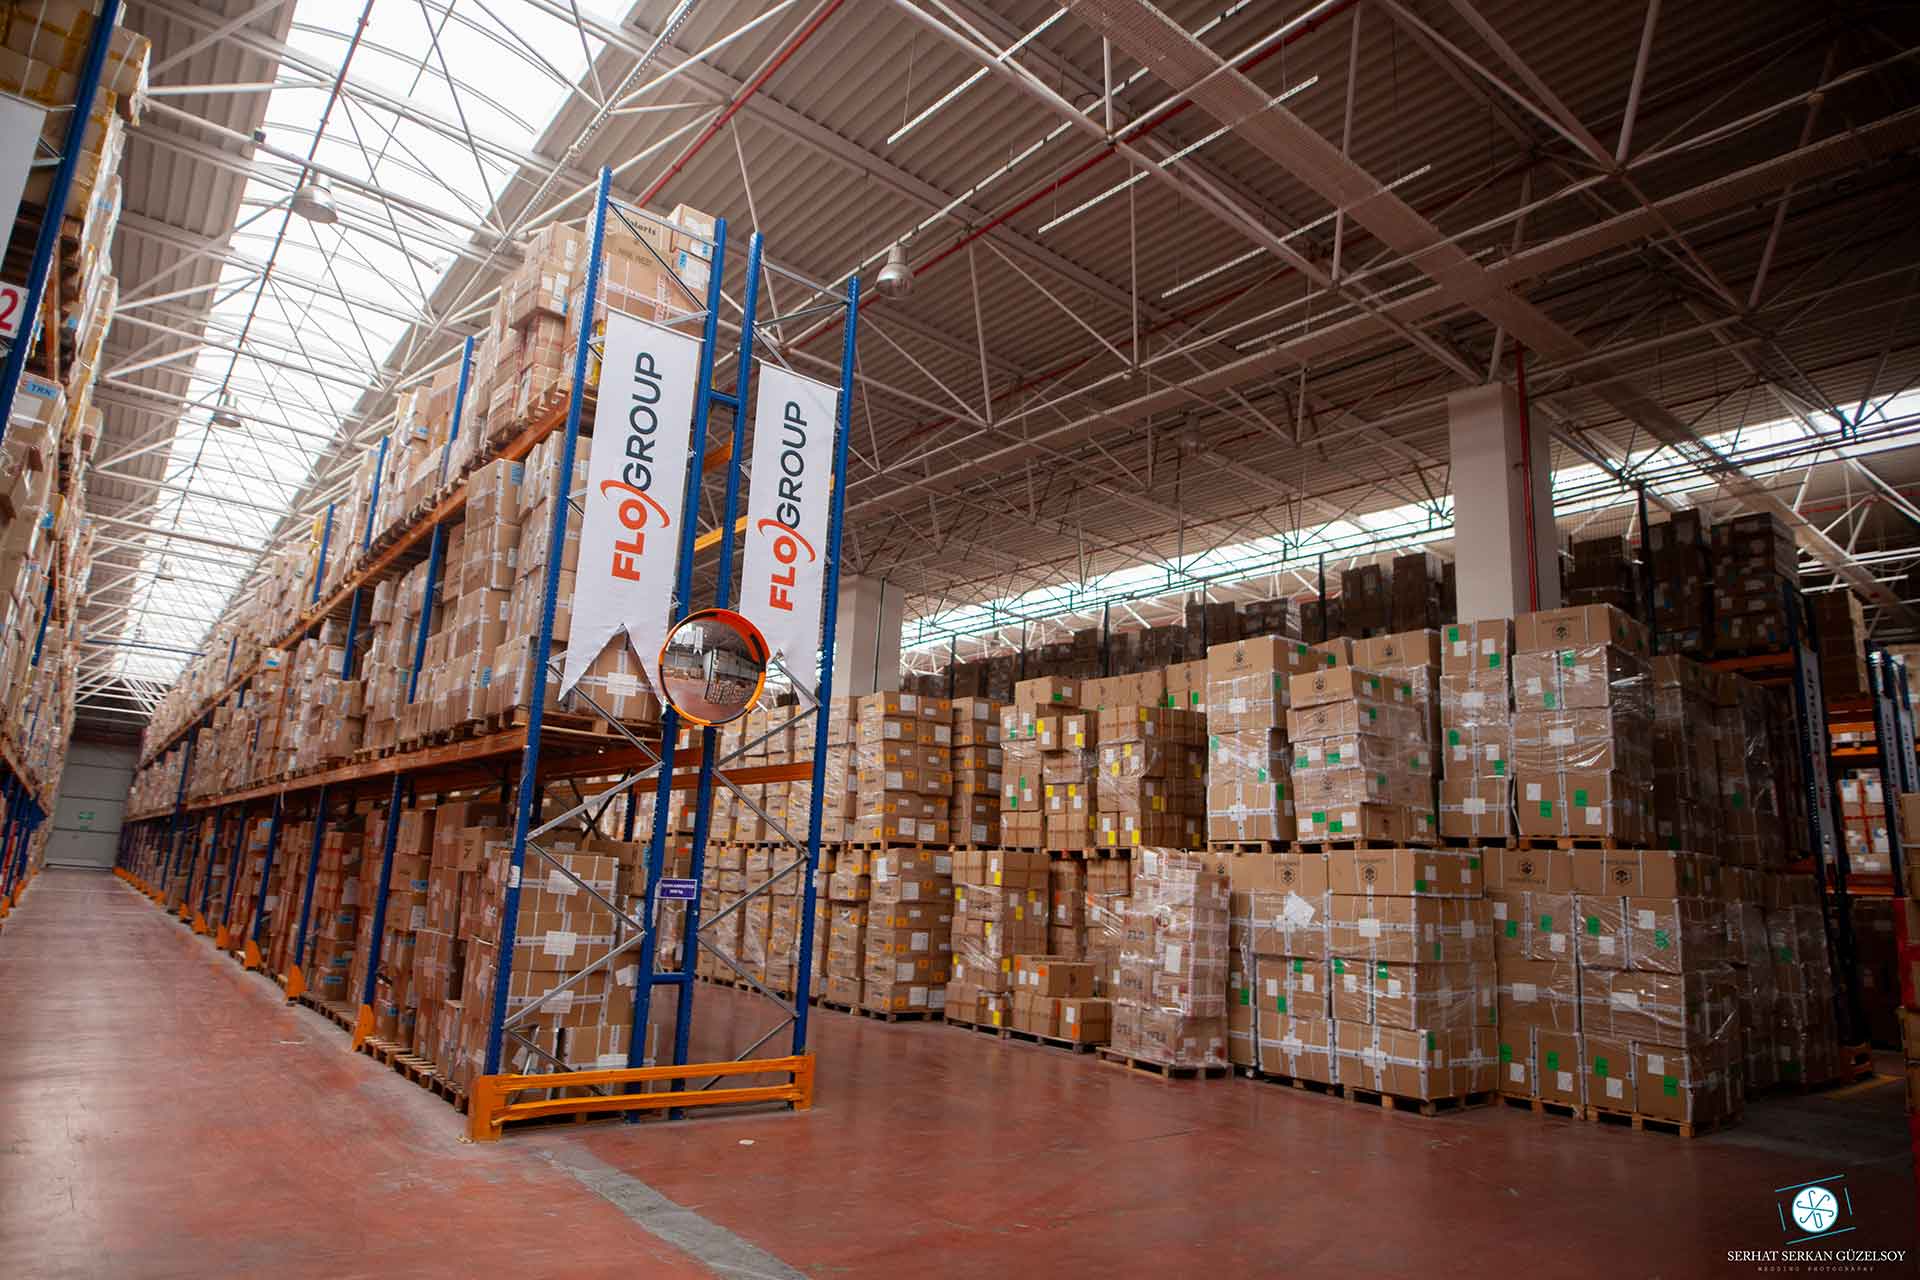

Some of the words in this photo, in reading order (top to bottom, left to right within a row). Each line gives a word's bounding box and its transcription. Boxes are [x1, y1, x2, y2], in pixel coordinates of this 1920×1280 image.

[0, 288, 19, 332] 2
[623, 352, 662, 491] GROUP
[776, 401, 807, 529] GROUP
[611, 498, 648, 581] FLO
[769, 535, 798, 611] FLO
